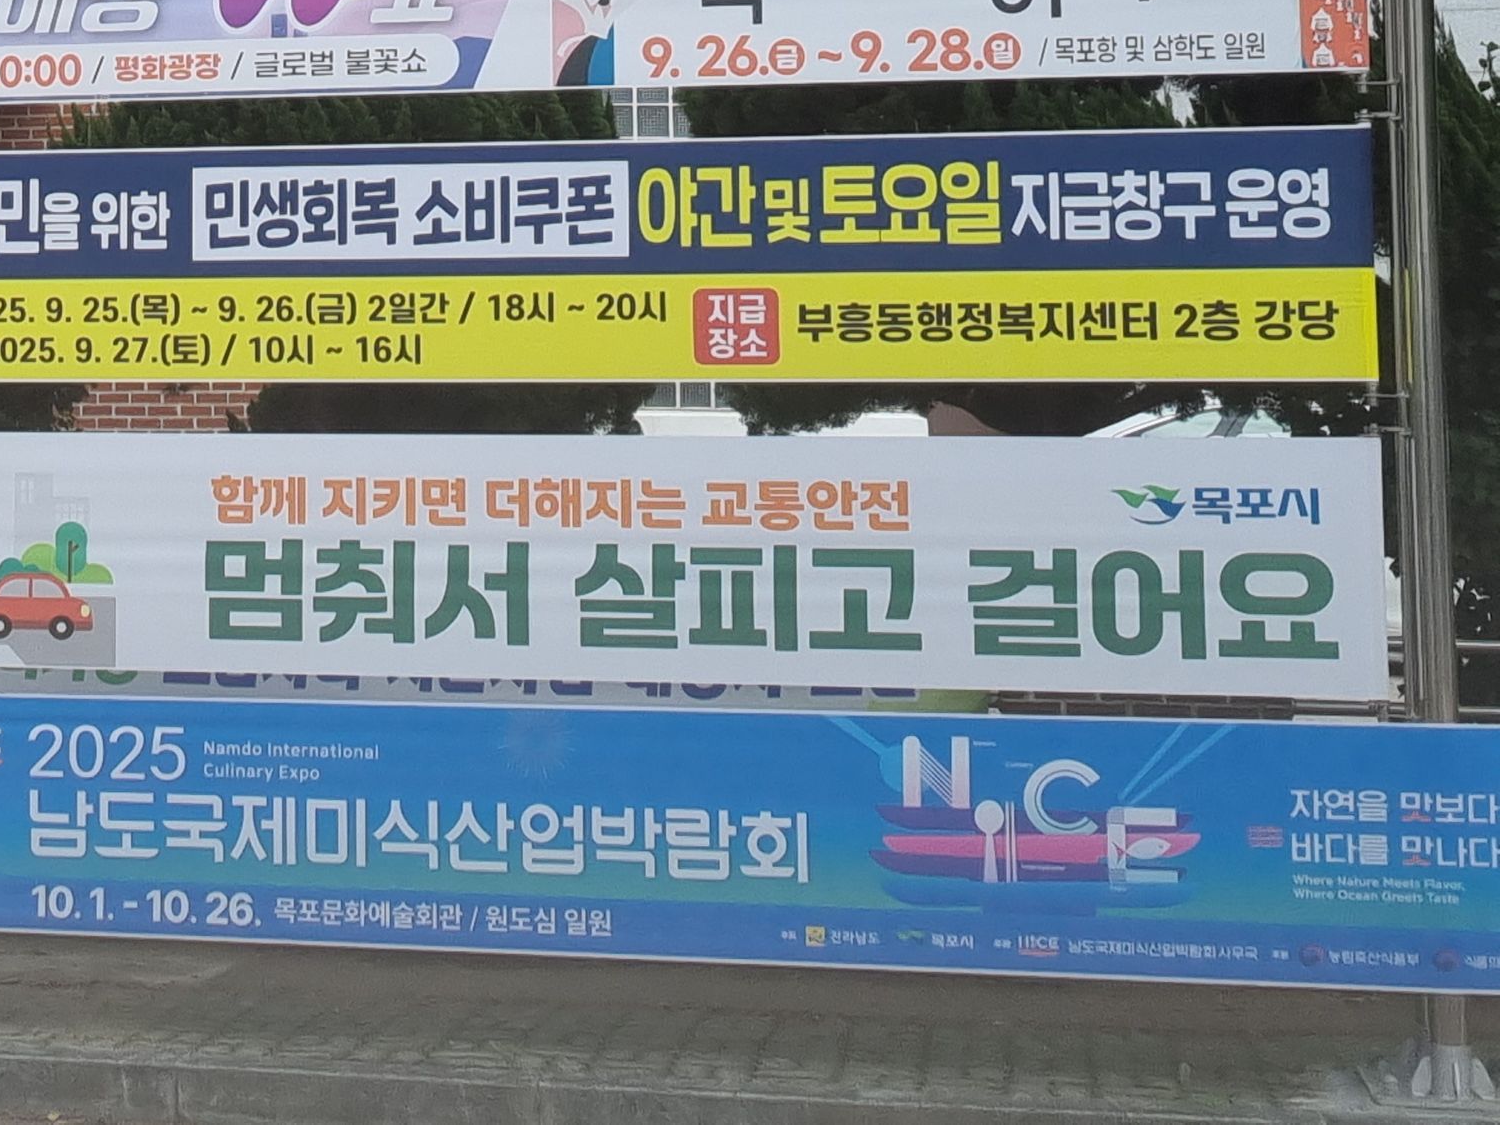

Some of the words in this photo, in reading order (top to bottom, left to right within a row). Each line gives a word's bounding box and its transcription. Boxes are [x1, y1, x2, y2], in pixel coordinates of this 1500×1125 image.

[114, 52, 222, 82] 평화광장
[254, 49, 334, 79] 글로벌
[345, 47, 428, 76] 불꽃쇼
[642, 36, 681, 79] 9.
[1055, 36, 1117, 64] 목포항
[1125, 36, 1145, 62] 및
[1153, 33, 1217, 62] 삼학도
[1224, 32, 1267, 60] 일원
[90, 190, 171, 250] 위한
[205, 177, 400, 250] 민생회복
[412, 174, 615, 246] 소비쿠폰
[637, 165, 757, 248] 야간
[764, 178, 811, 244] 및
[819, 160, 1002, 245] 토요일
[1010, 169, 1217, 242] 지급창구
[1225, 167, 1332, 240] 운영
[45, 296, 73, 324] 9.
[83, 293, 181, 327] 25.(목)
[217, 295, 246, 323] 9.
[256, 291, 358, 325] 26.(금)
[367, 291, 450, 325] 2일간
[487, 290, 555, 323] 18시
[596, 290, 667, 323] 20시
[707, 293, 767, 326] 지급
[797, 301, 1159, 343] 부흥동행정복지센터
[1173, 300, 1241, 342] 2층
[1254, 300, 1339, 342] 강당
[75, 336, 102, 364] 9.
[112, 333, 211, 367] 27.(토)
[248, 333, 314, 365] 10시
[355, 333, 422, 365] 16시
[708, 328, 768, 360] 장소
[211, 475, 306, 526] 함께
[321, 476, 467, 527] 지키면
[485, 477, 687, 529] 더해지는
[700, 479, 911, 532] 교통안전
[1192, 486, 1320, 526] 목포시
[204, 537, 531, 647] 멈춰서
[574, 542, 924, 653] 살피고
[968, 548, 1340, 660] 걸어요
[27, 723, 187, 782] 2025
[203, 740, 262, 756] Namdo
[267, 741, 380, 760] International
[203, 763, 274, 783] Culinary
[278, 764, 320, 784] Expo
[1290, 789, 1388, 823] 자연을
[1400, 791, 1500, 825] 맛보다
[28, 788, 810, 884] 남도국제미식산업박람회
[1291, 833, 1389, 865] 바다를
[1401, 835, 1500, 868] 맛나다
[1293, 875, 1334, 886] Where
[1293, 889, 1334, 900] Where
[1338, 890, 1378, 901] Ocean
[31, 885, 81, 920] 10.
[89, 887, 115, 922] 1.
[146, 890, 197, 925] 10.
[205, 891, 262, 927] 26.
[274, 897, 463, 932] 목포문화예술회관
[485, 906, 556, 936] 원도심
[563, 907, 613, 937] 일원
